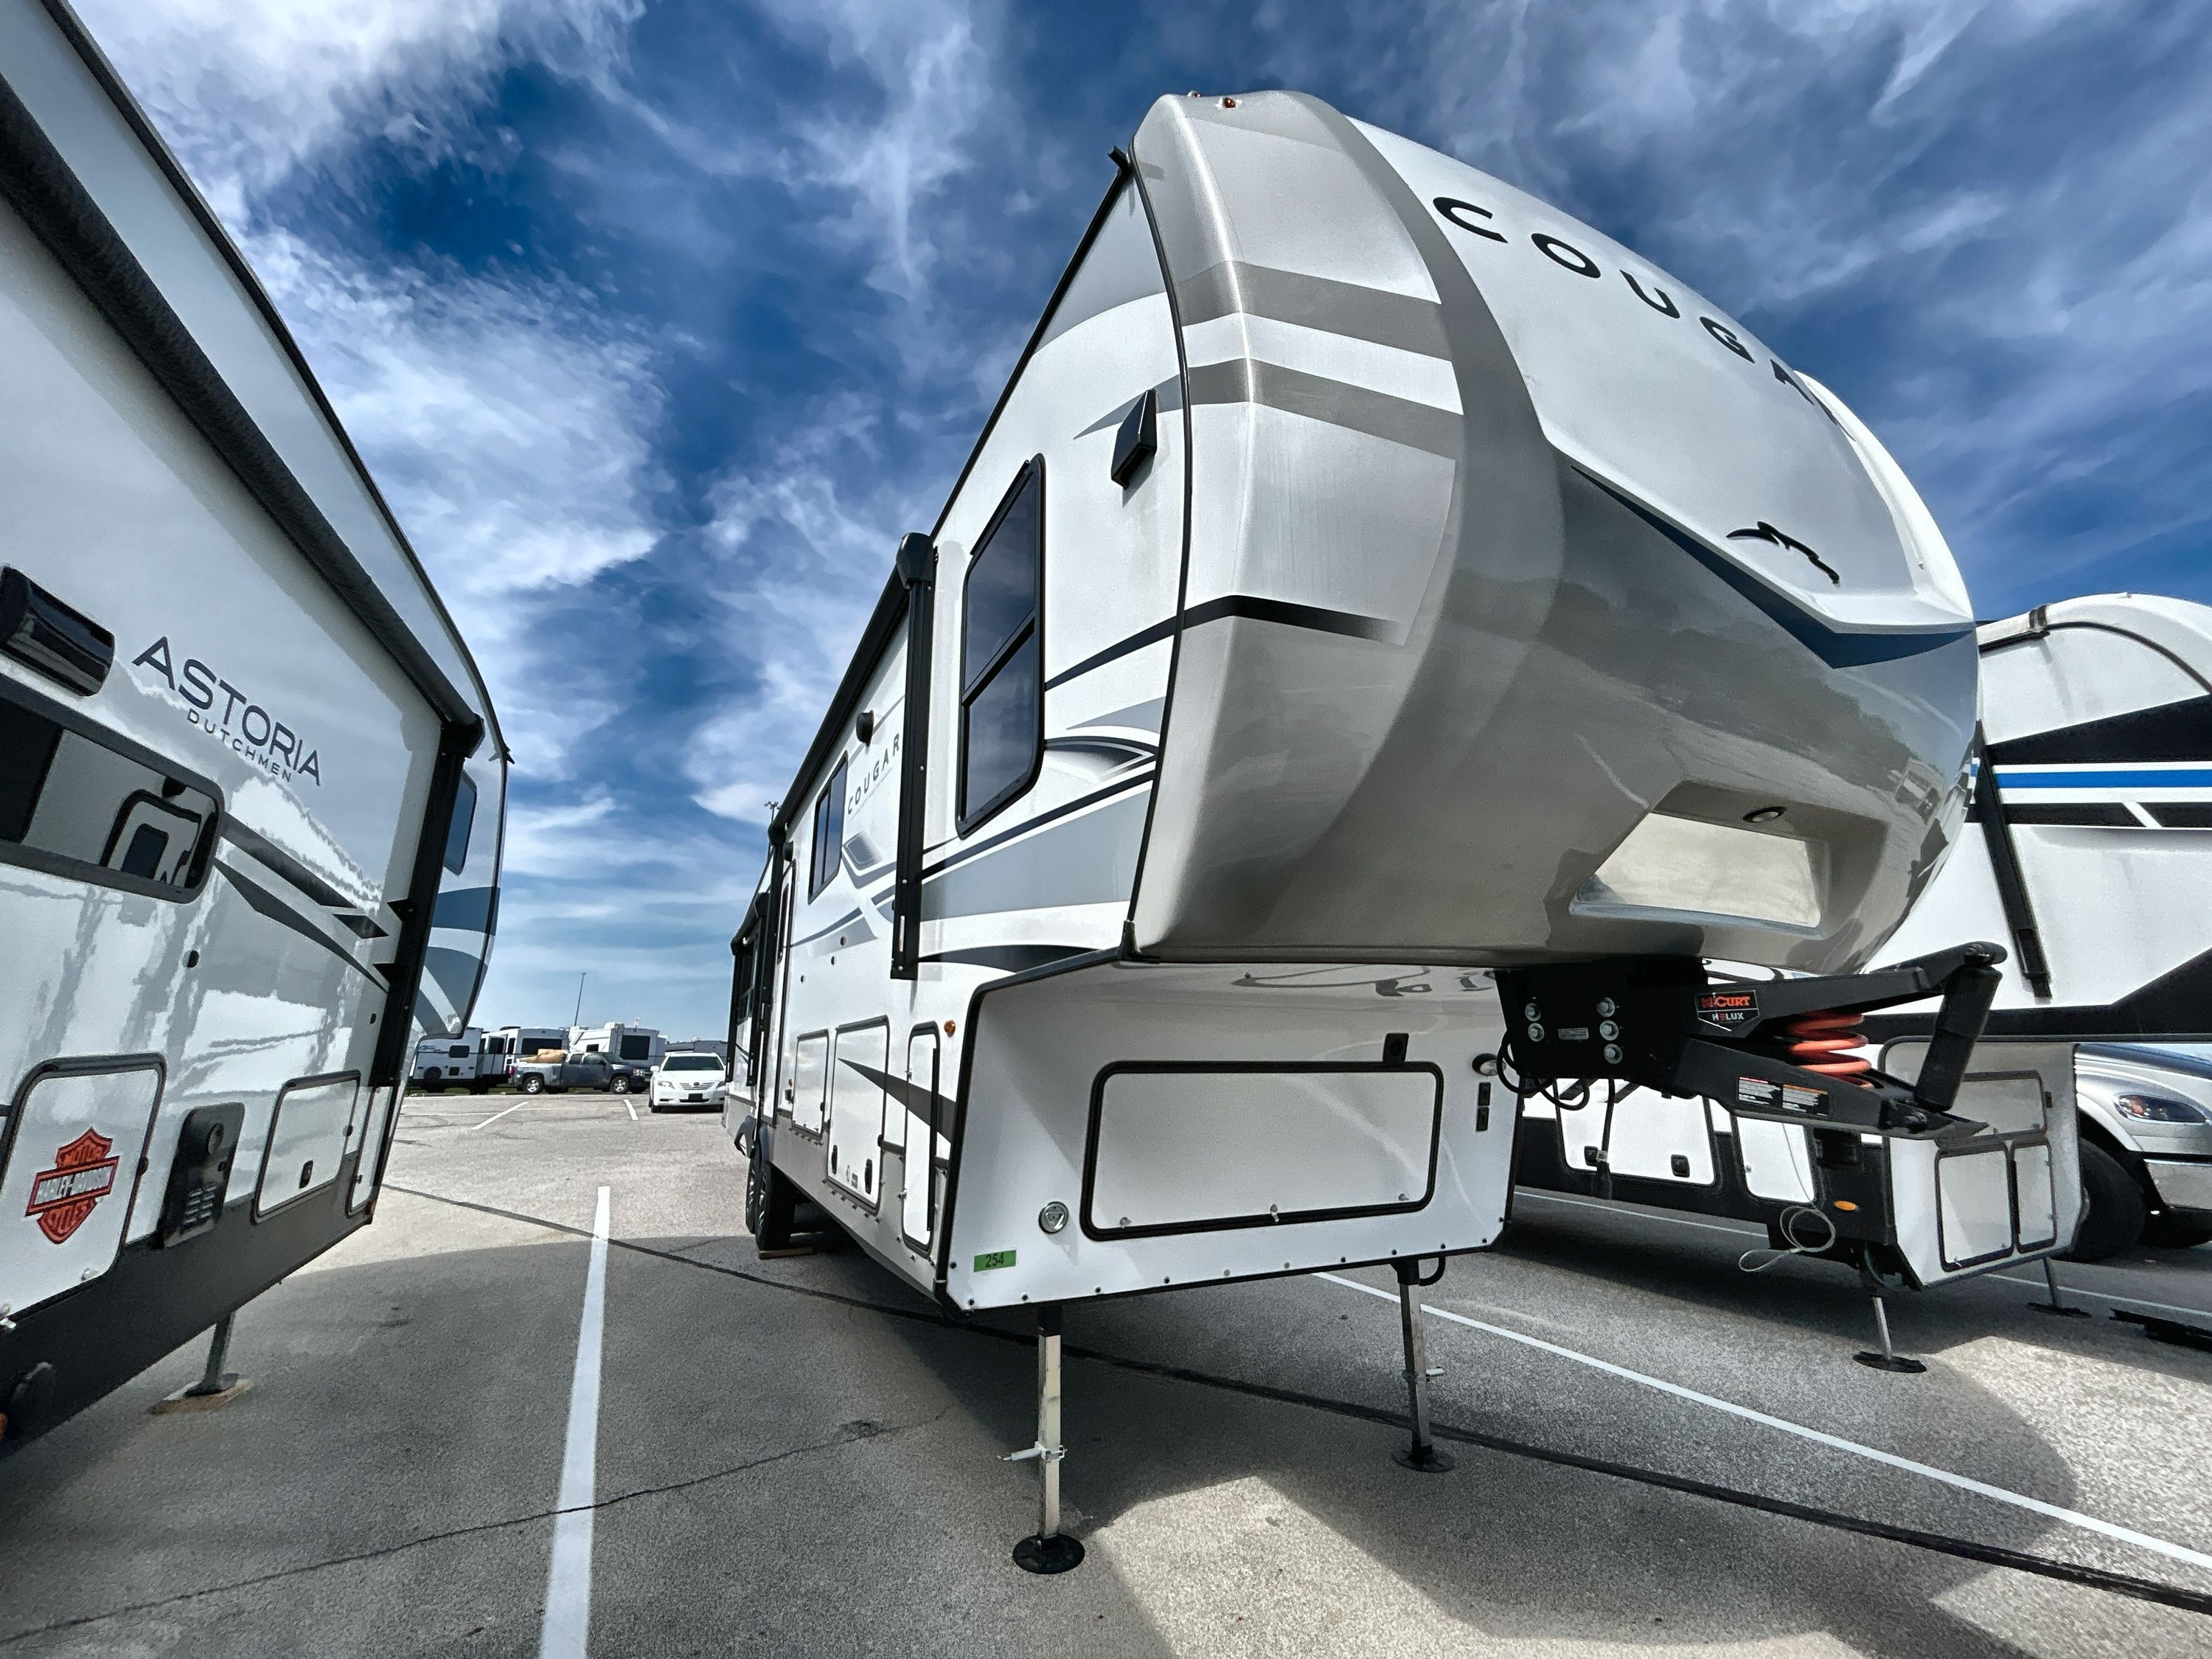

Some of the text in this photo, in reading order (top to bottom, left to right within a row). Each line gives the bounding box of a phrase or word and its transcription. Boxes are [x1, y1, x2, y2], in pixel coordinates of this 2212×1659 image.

[132, 636, 320, 787] ASTORIA
[187, 708, 291, 782] DUTCHMEN
[847, 733, 900, 815] COUGAR
[1714, 995, 1750, 1007] CURT
[985, 1252, 1004, 1267] 254
